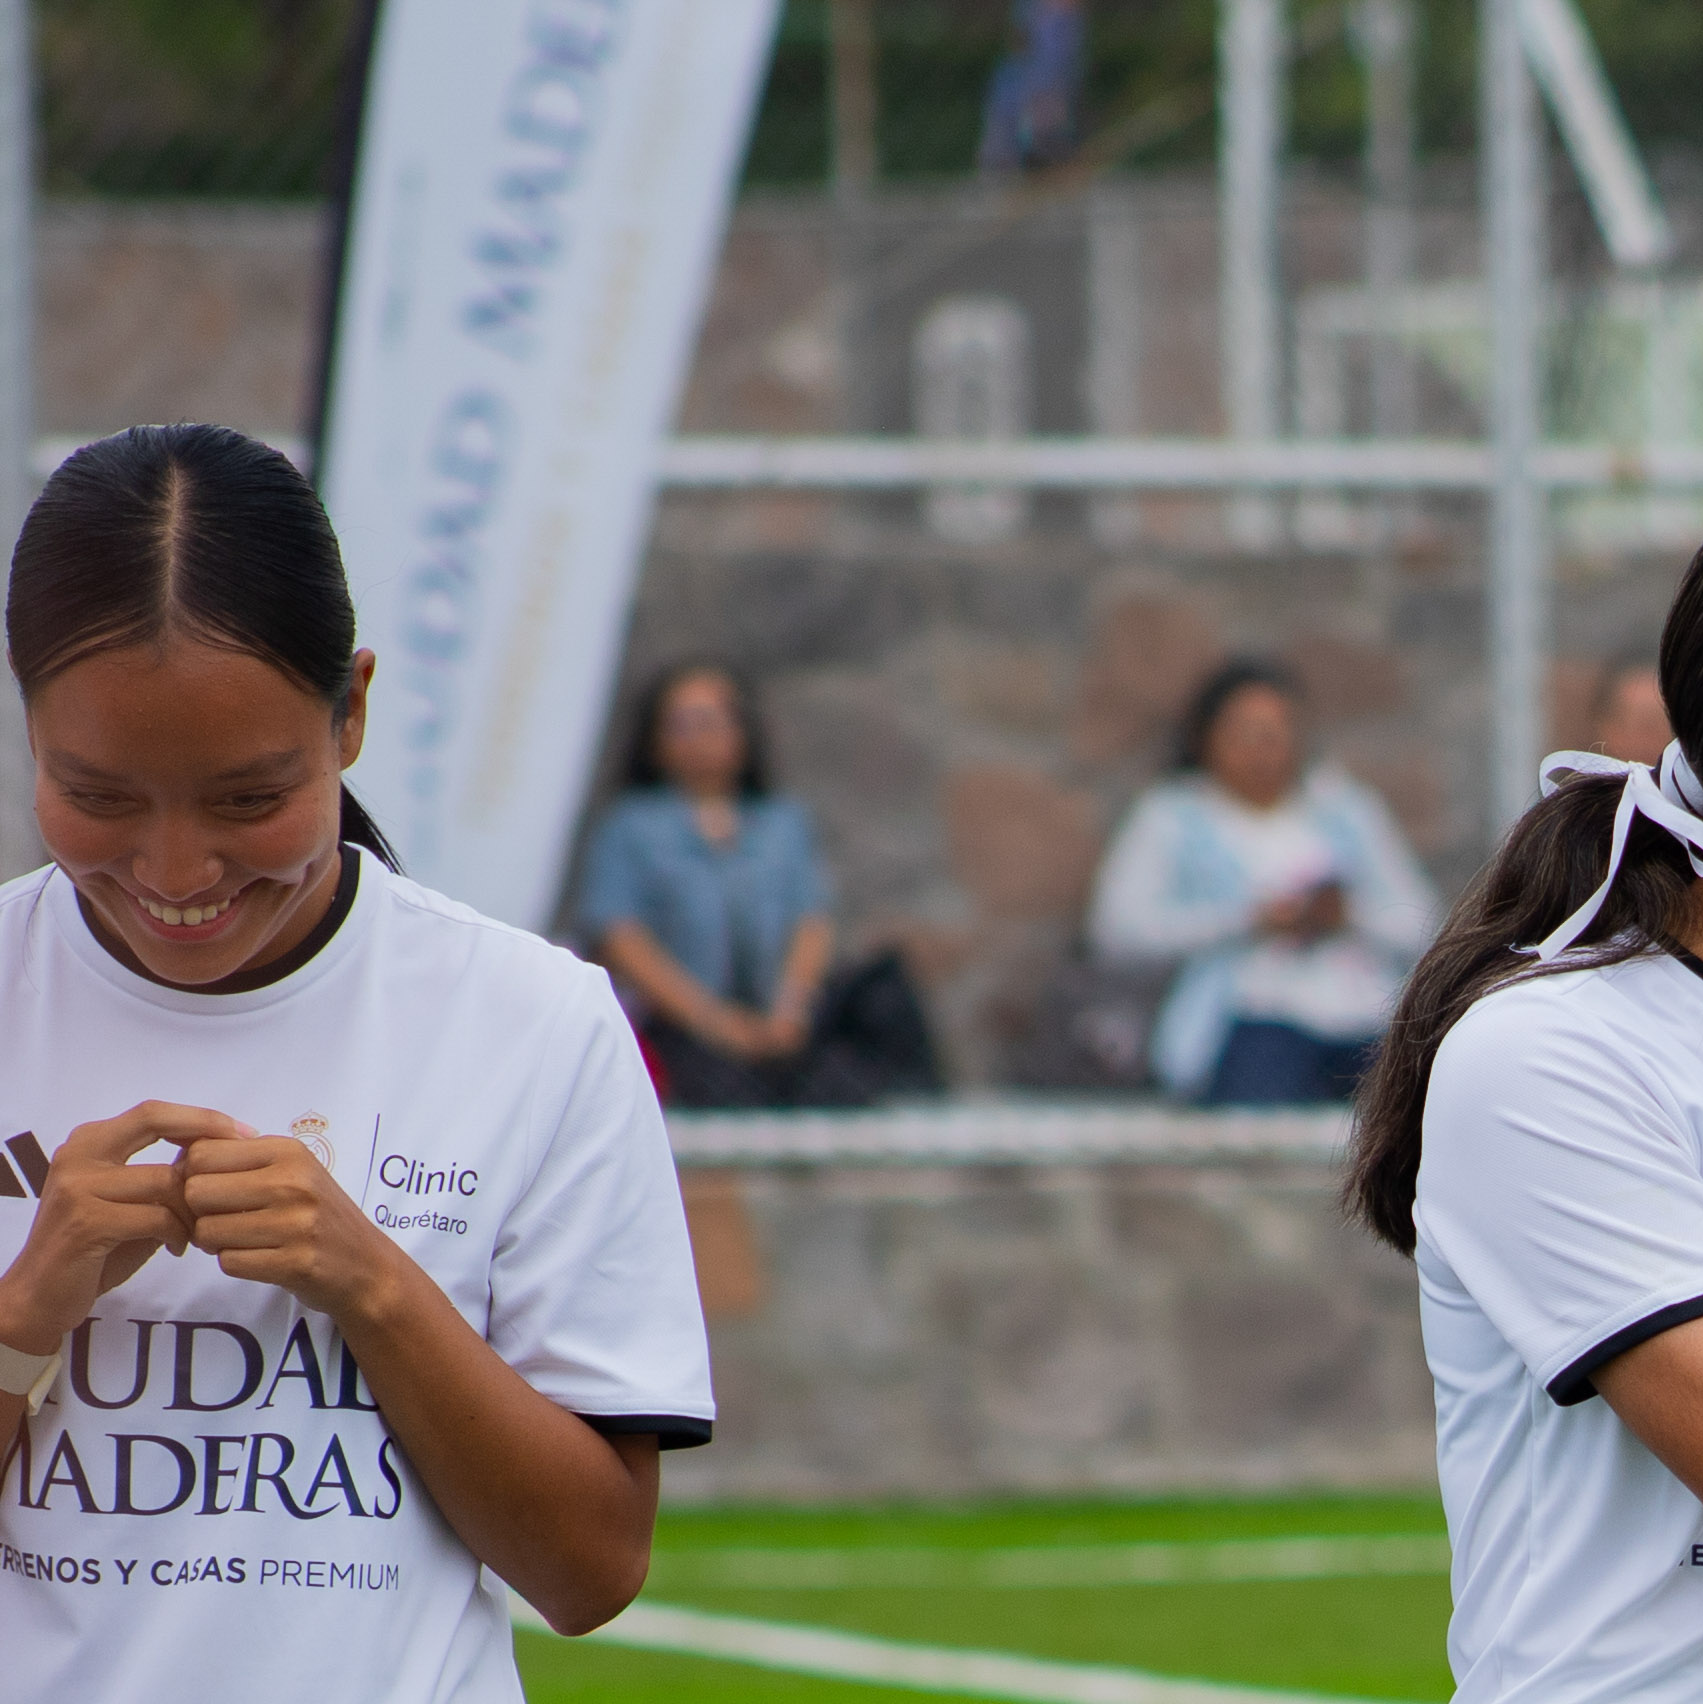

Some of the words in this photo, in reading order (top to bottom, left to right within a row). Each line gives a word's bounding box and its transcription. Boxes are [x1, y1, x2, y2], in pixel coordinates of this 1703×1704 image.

[380, 1154, 478, 1196] Clinic
[374, 1204, 468, 1235] Querétaro
[44, 1316, 380, 1412] UDA
[0, 1543, 101, 1585] RRENOS
[114, 1559, 138, 1585] Y
[151, 1556, 246, 1586] CASAS
[260, 1559, 399, 1590] PREMIUM
